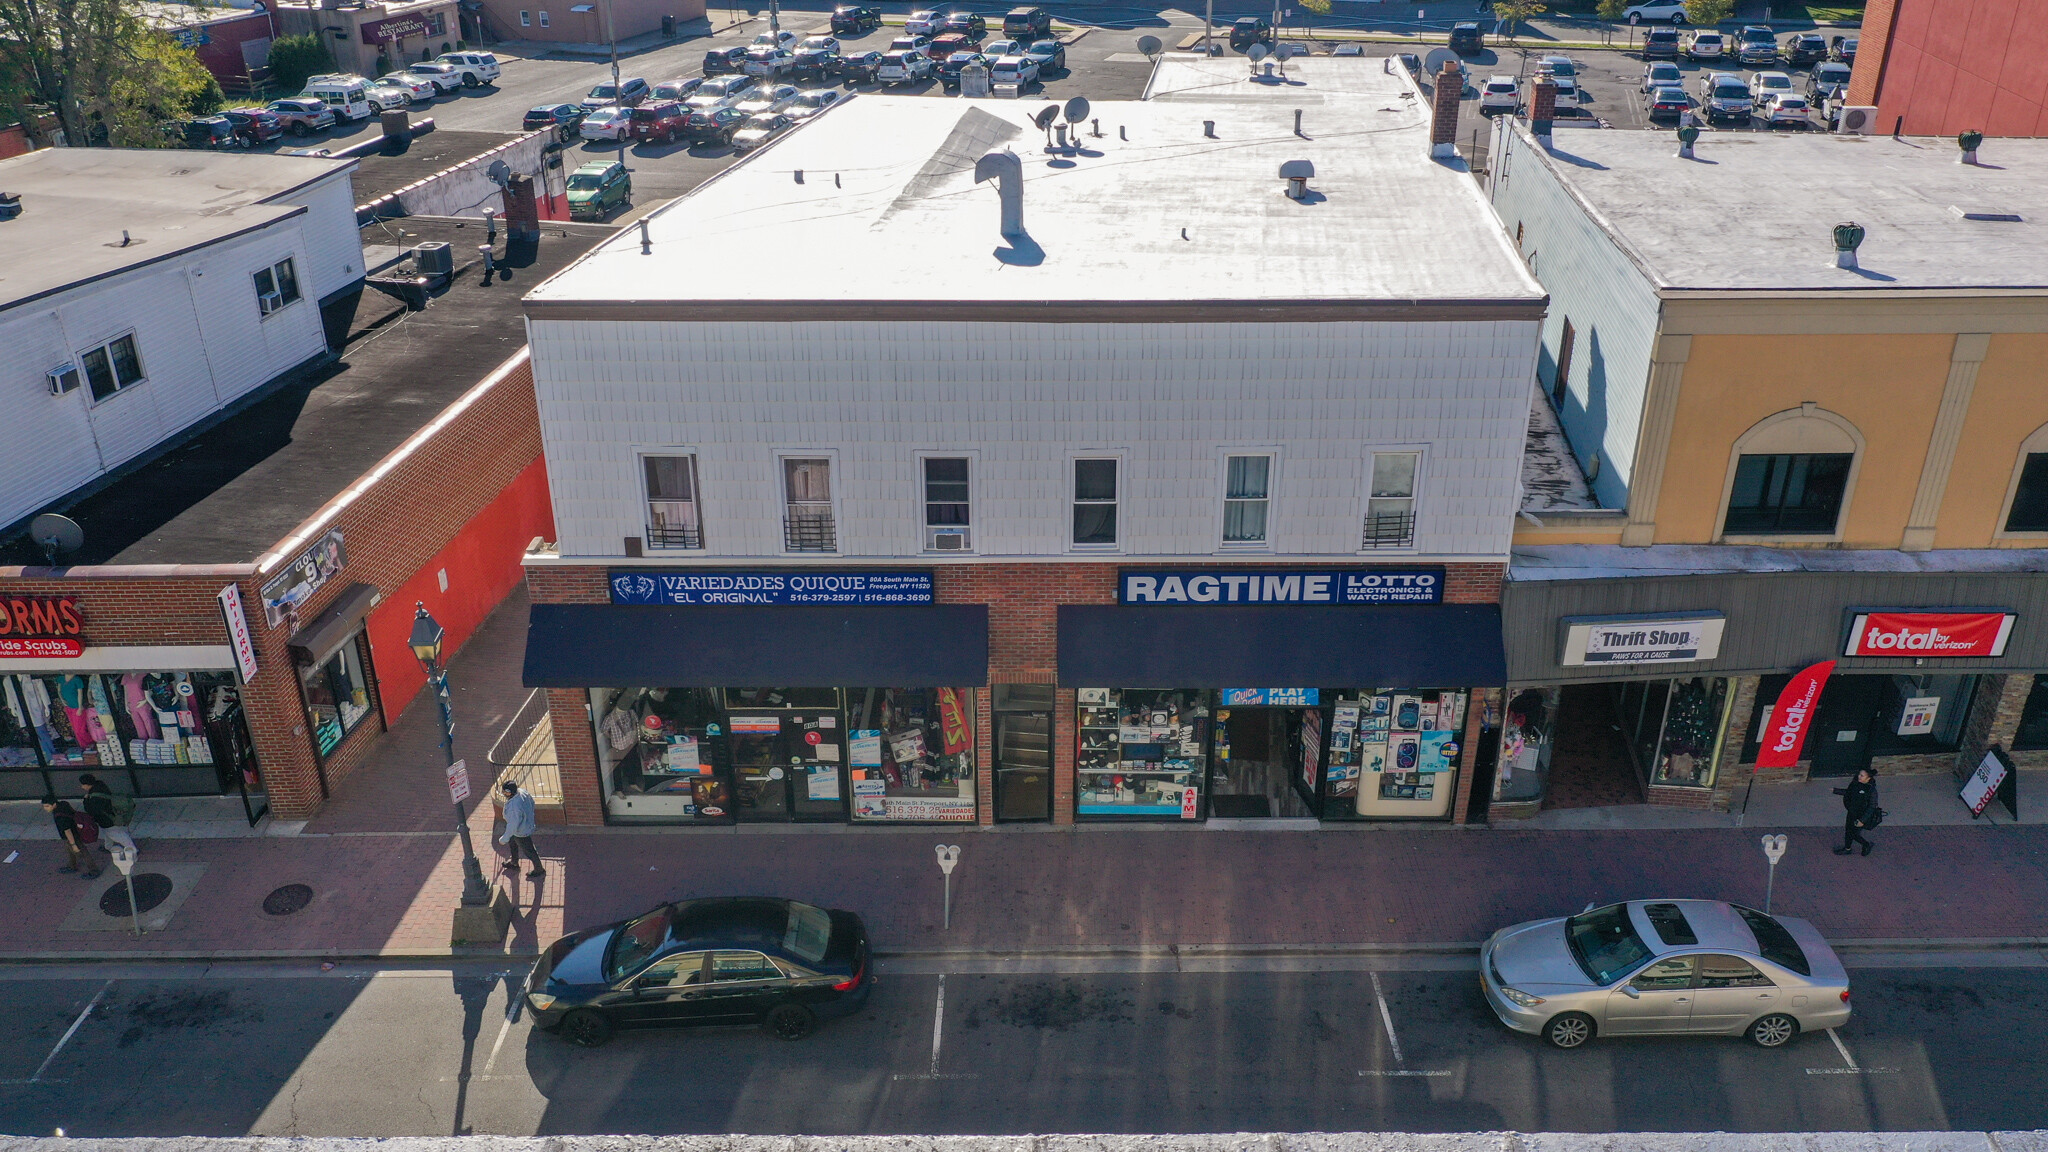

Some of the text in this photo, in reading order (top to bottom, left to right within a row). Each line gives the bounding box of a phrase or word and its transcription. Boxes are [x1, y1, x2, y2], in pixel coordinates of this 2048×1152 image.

[377, 22, 424, 37] RESTAURANT
[295, 549, 317, 572] CLOU
[305, 562, 318, 583] 9
[662, 577, 866, 591] VARIEDADES QUIQUE
[1127, 575, 1331, 602] RAGTIME
[1347, 575, 1436, 587] LOTTO
[702, 592, 778, 603] ORIGINAL"
[226, 590, 252, 665] UNIFORMS
[24, 641, 67, 650] Scrubs
[1603, 631, 1690, 646] Thrift Shop
[1867, 627, 1949, 650] total by
[1934, 640, 1972, 649] verizon
[1611, 652, 1629, 660] PAWS
[1269, 688, 1304, 696] PLAY
[1803, 679, 1818, 708] verizon
[1269, 696, 1311, 705] HERE.
[1773, 699, 1807, 752] total by
[1977, 768, 1988, 784] $30
[1184, 789, 1194, 811] ATM
[1972, 786, 1996, 815] total
